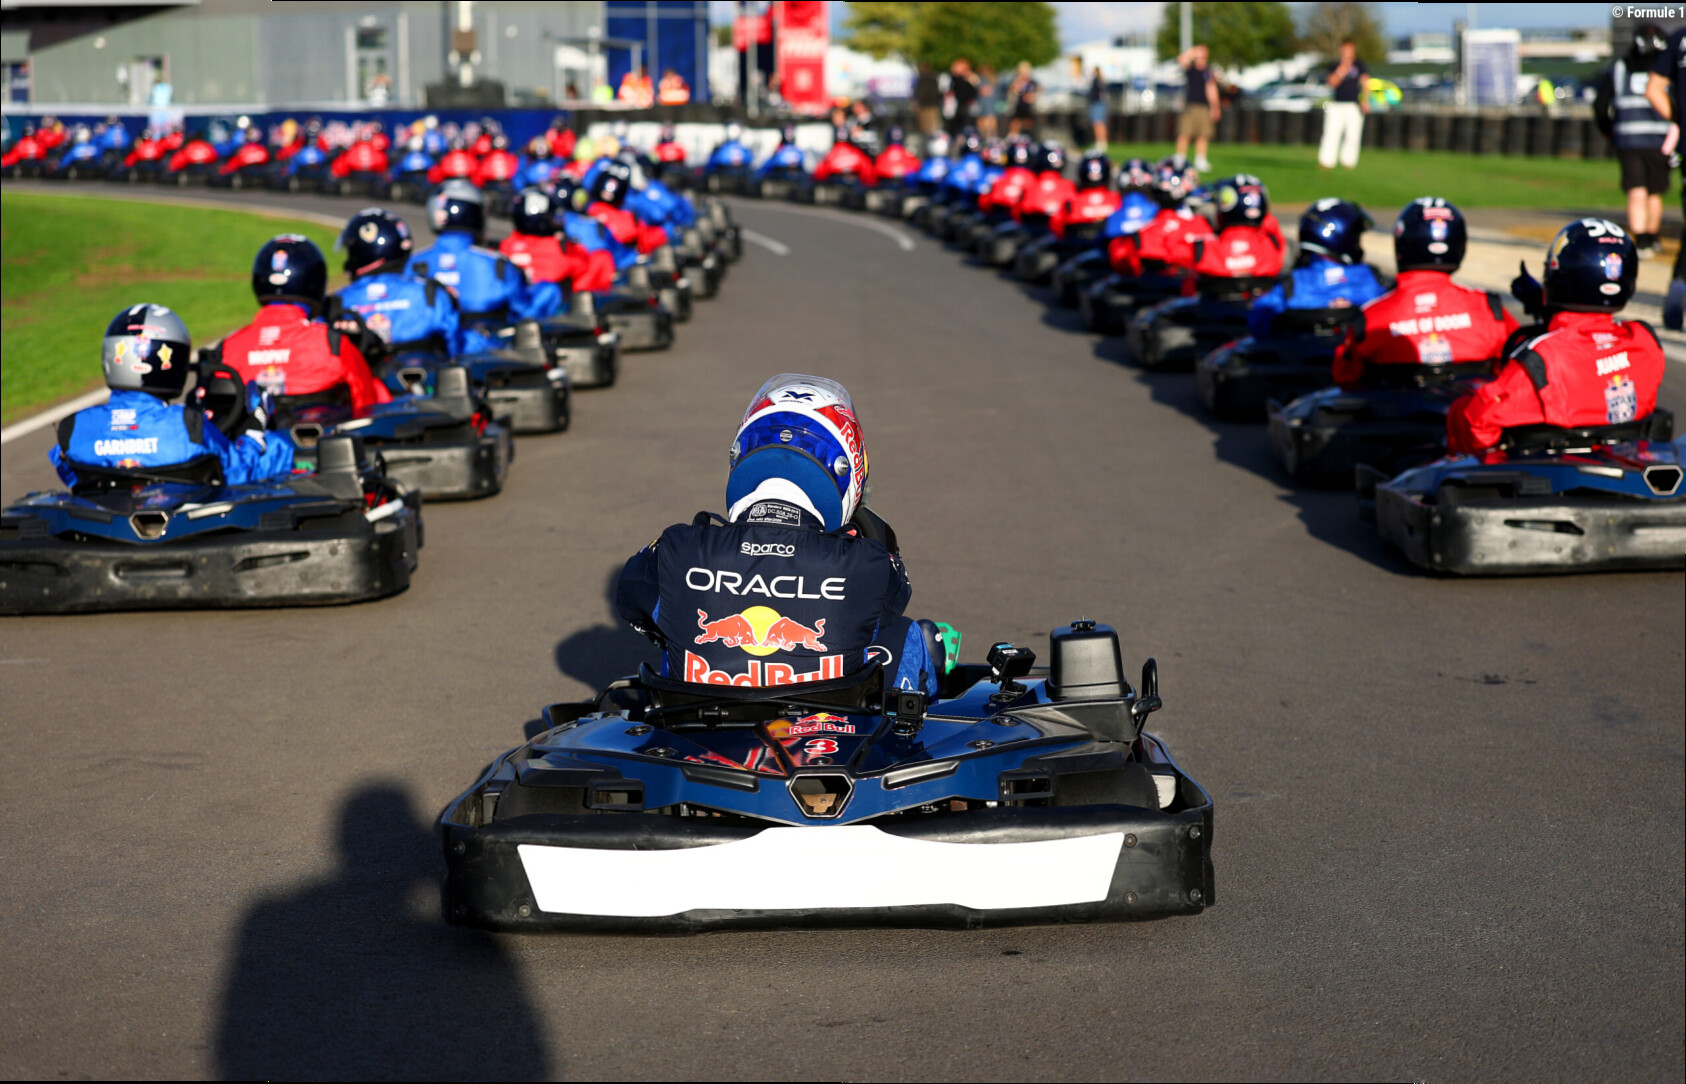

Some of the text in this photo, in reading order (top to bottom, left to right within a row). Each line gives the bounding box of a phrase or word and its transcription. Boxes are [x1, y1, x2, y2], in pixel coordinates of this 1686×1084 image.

[840, 421, 864, 469] Red
[741, 541, 796, 557] sparco
[685, 567, 847, 601] ORACLE
[684, 649, 762, 688] Red
[789, 722, 856, 735] Red Bull
[803, 738, 839, 755] 3
